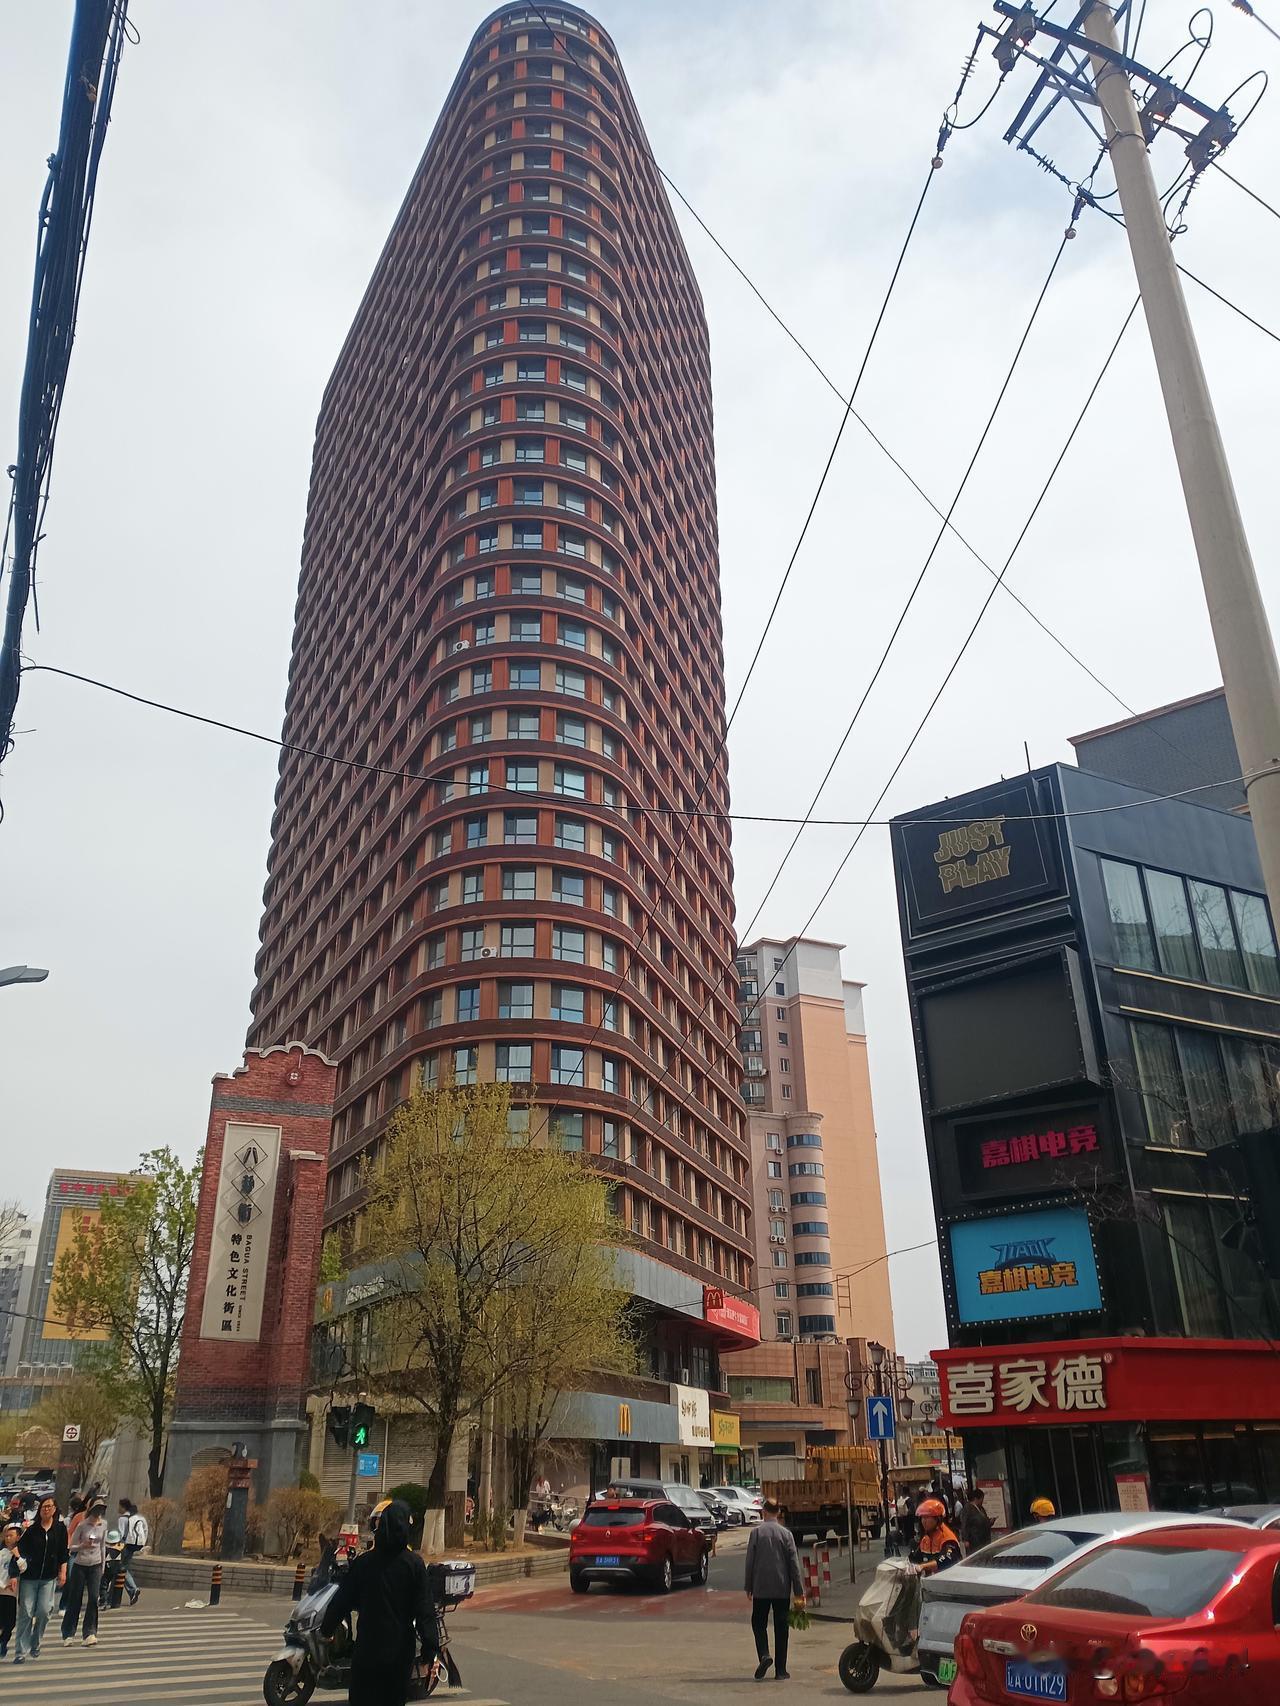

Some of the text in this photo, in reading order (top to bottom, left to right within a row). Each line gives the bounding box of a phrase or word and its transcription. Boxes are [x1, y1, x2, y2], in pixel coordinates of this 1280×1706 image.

[933, 815, 1005, 863] JUST
[939, 846, 1011, 894] PLAY
[982, 1125, 1099, 1168] 嘉棋电竞
[243, 1234, 253, 1264] BAGUA
[239, 1268, 249, 1301] STREET
[978, 1262, 1079, 1295] 嘉棋电竞
[946, 1355, 1107, 1414] 喜家德
